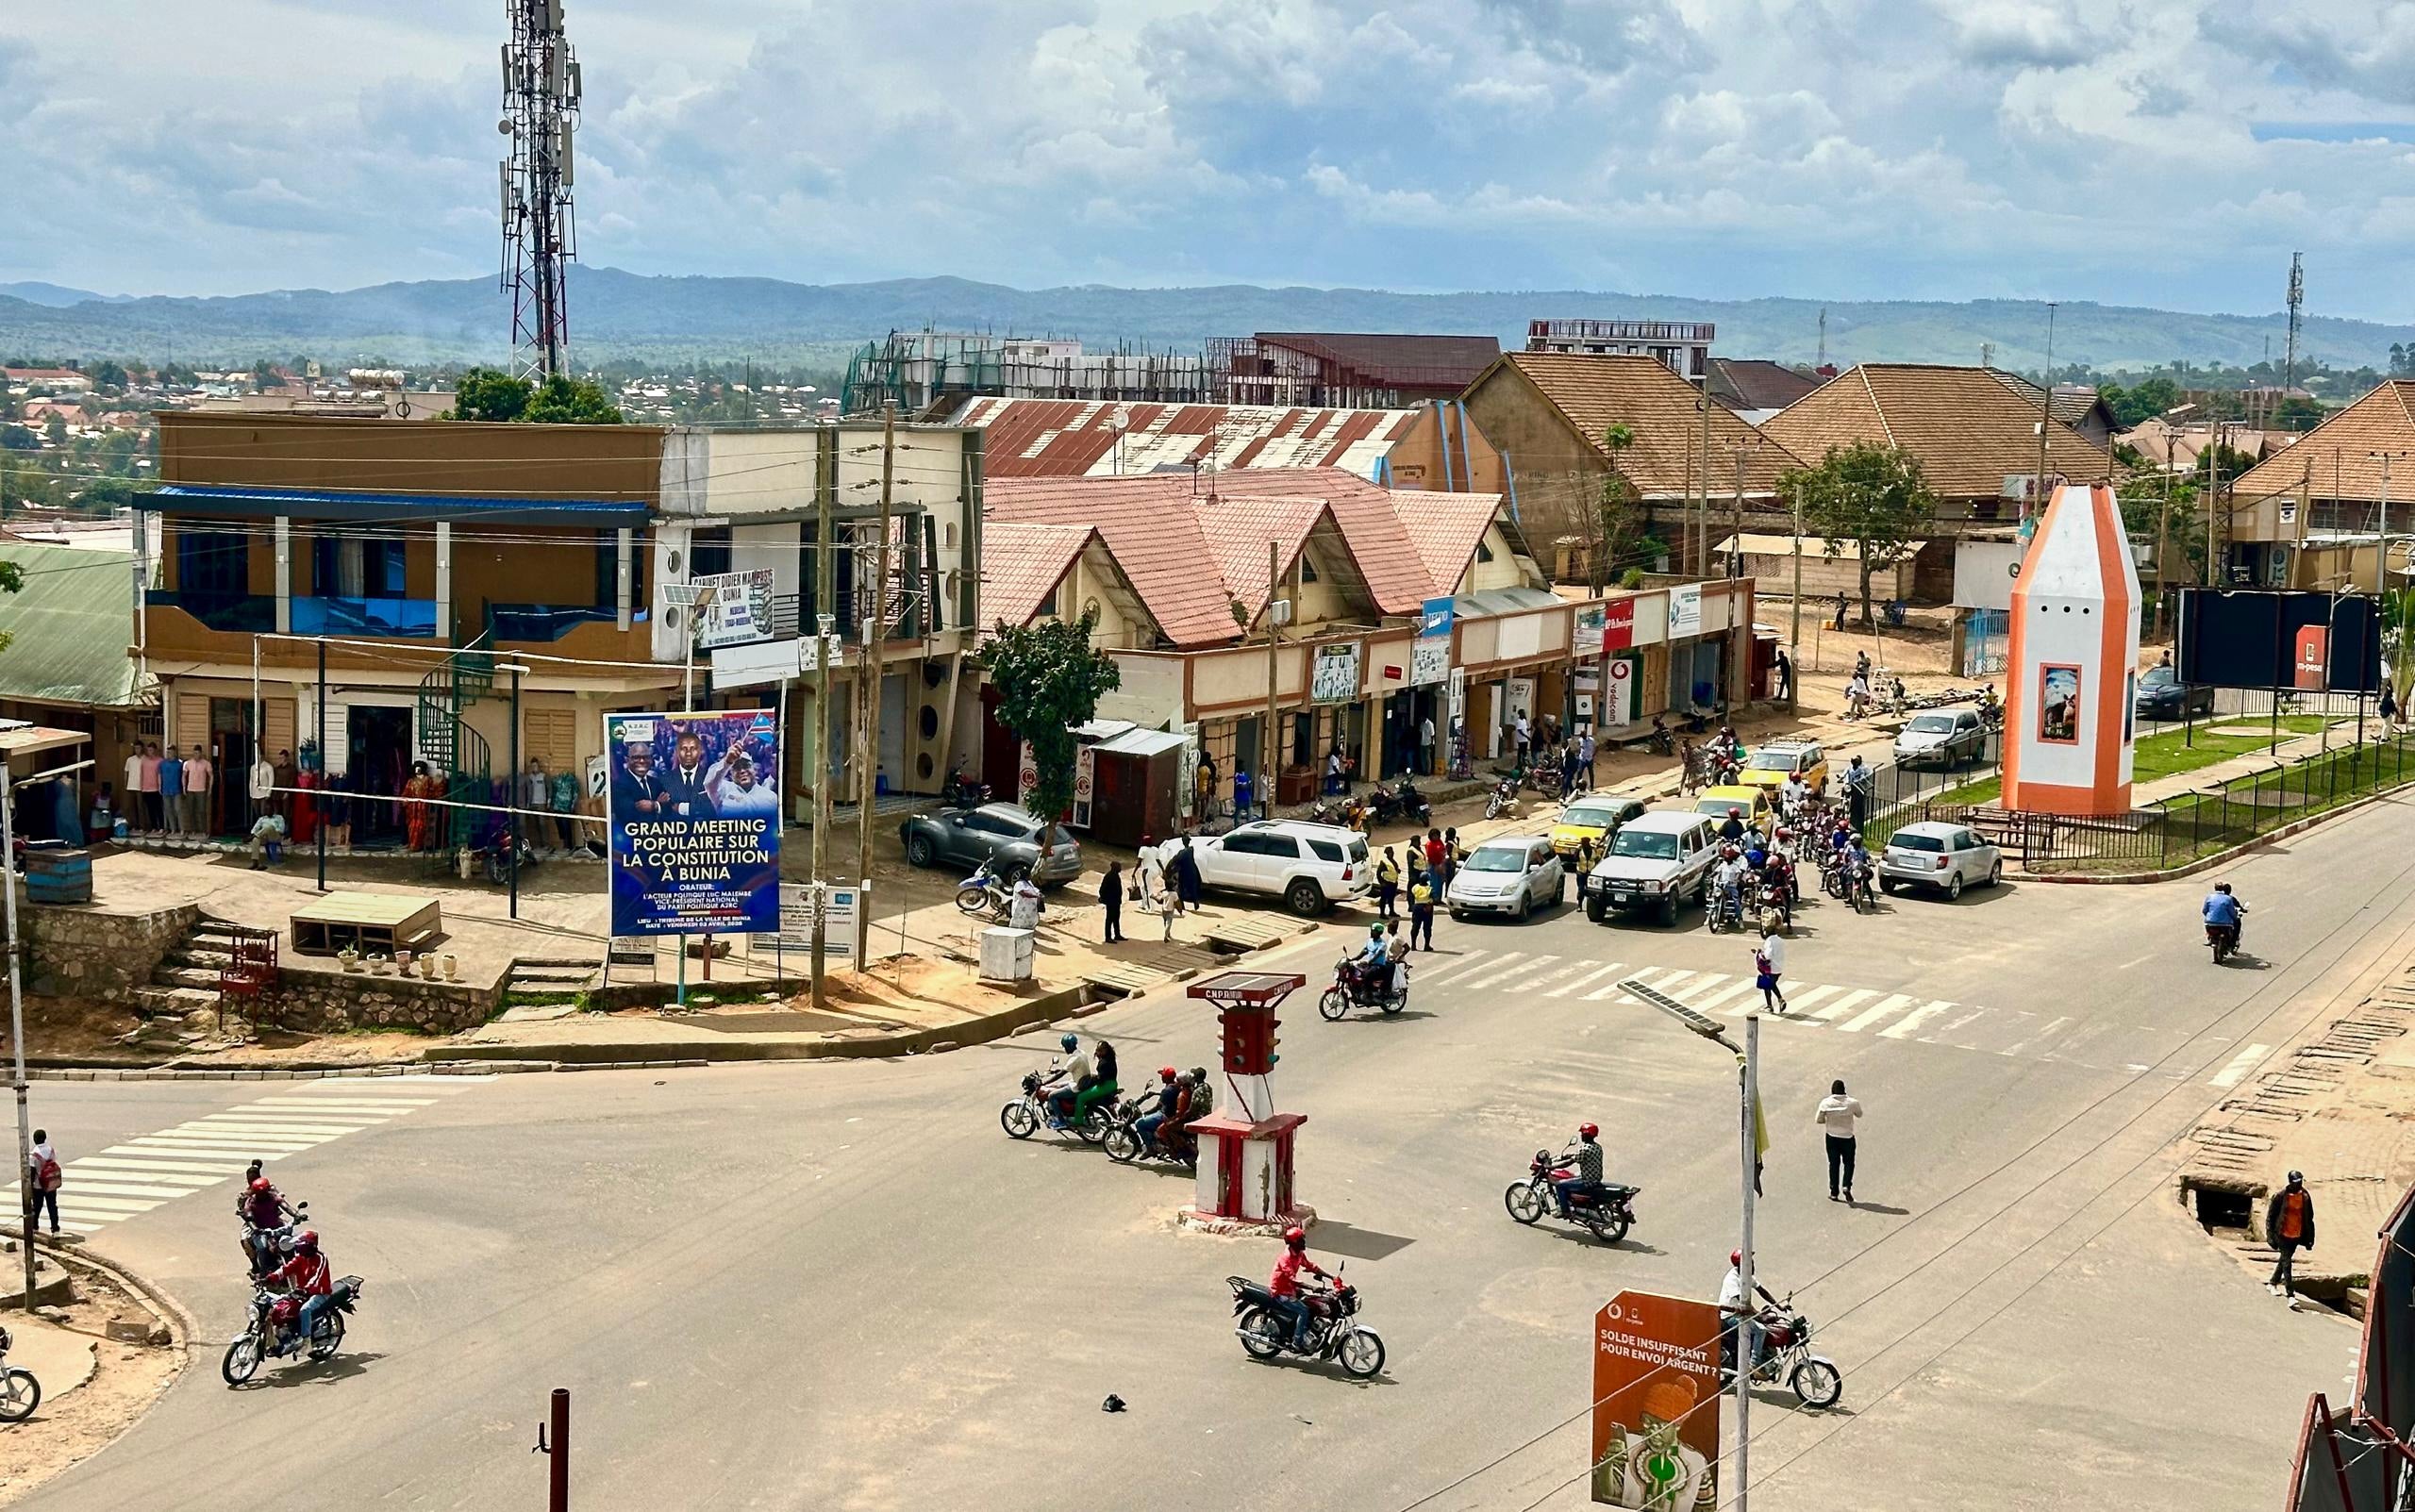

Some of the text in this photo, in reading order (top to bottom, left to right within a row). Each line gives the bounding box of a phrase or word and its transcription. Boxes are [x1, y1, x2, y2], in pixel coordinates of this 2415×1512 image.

[721, 573, 741, 589] DIDIER
[723, 588, 741, 602] BUNIA
[625, 819, 767, 836] GRAND MEETING
[633, 835, 758, 851] POPULAIRE SUR
[623, 850, 769, 868] LA CONSTITUTION
[660, 864, 731, 882] À BUNIA
[1600, 1328, 1707, 1362] SOLDE INSUFFISANT
[1600, 1341, 1630, 1357] POUR
[1631, 1348, 1665, 1365] ENVOI
[1666, 1356, 1710, 1376] ARGENT
